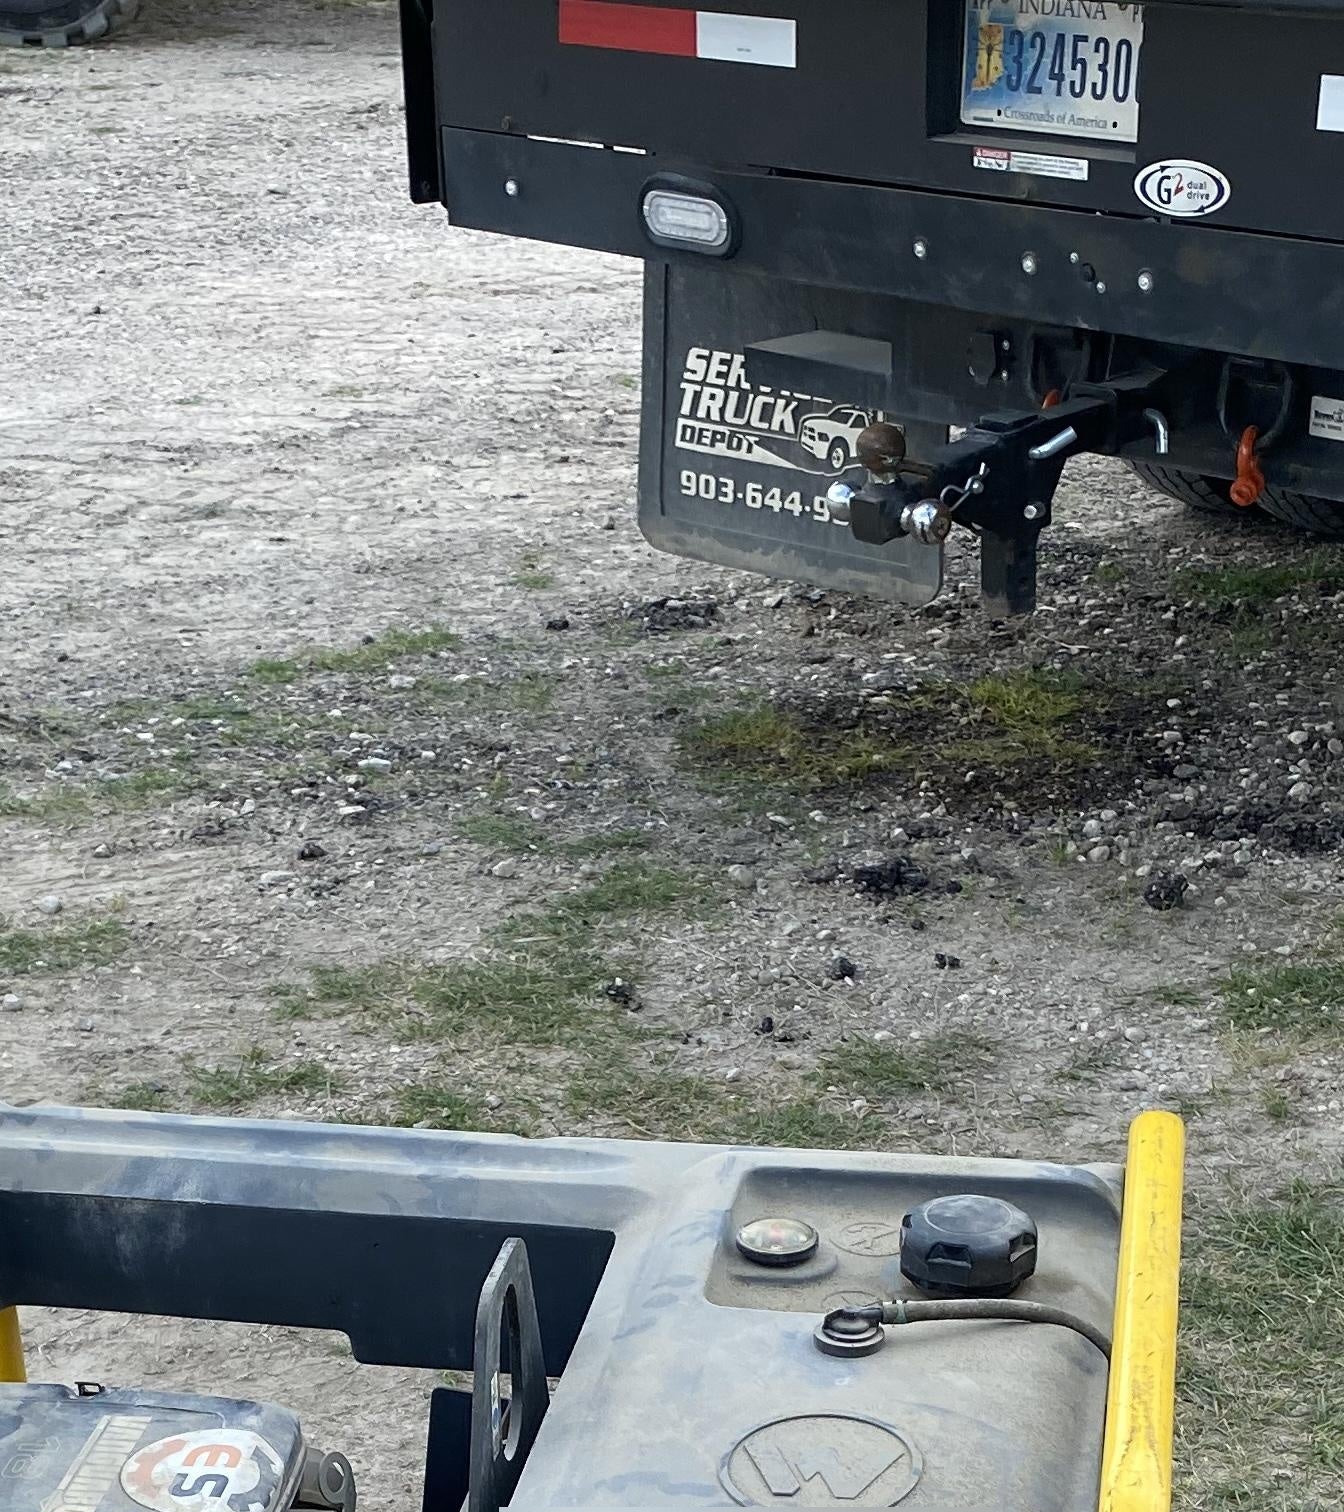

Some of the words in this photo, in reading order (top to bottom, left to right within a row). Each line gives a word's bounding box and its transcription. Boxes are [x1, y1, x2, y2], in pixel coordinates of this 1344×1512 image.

[1018, 0, 1107, 20] INDIANA
[1005, 29, 1133, 104] 324530
[1003, 106, 1055, 123] Crossroads
[1056, 112, 1066, 124] of
[1067, 113, 1108, 129] America
[1186, 181, 1207, 190] dual
[1186, 191, 1210, 201] drive
[679, 382, 799, 435] TRUCK
[680, 423, 760, 454] DEPOT
[680, 469, 850, 526] 903-644-9
